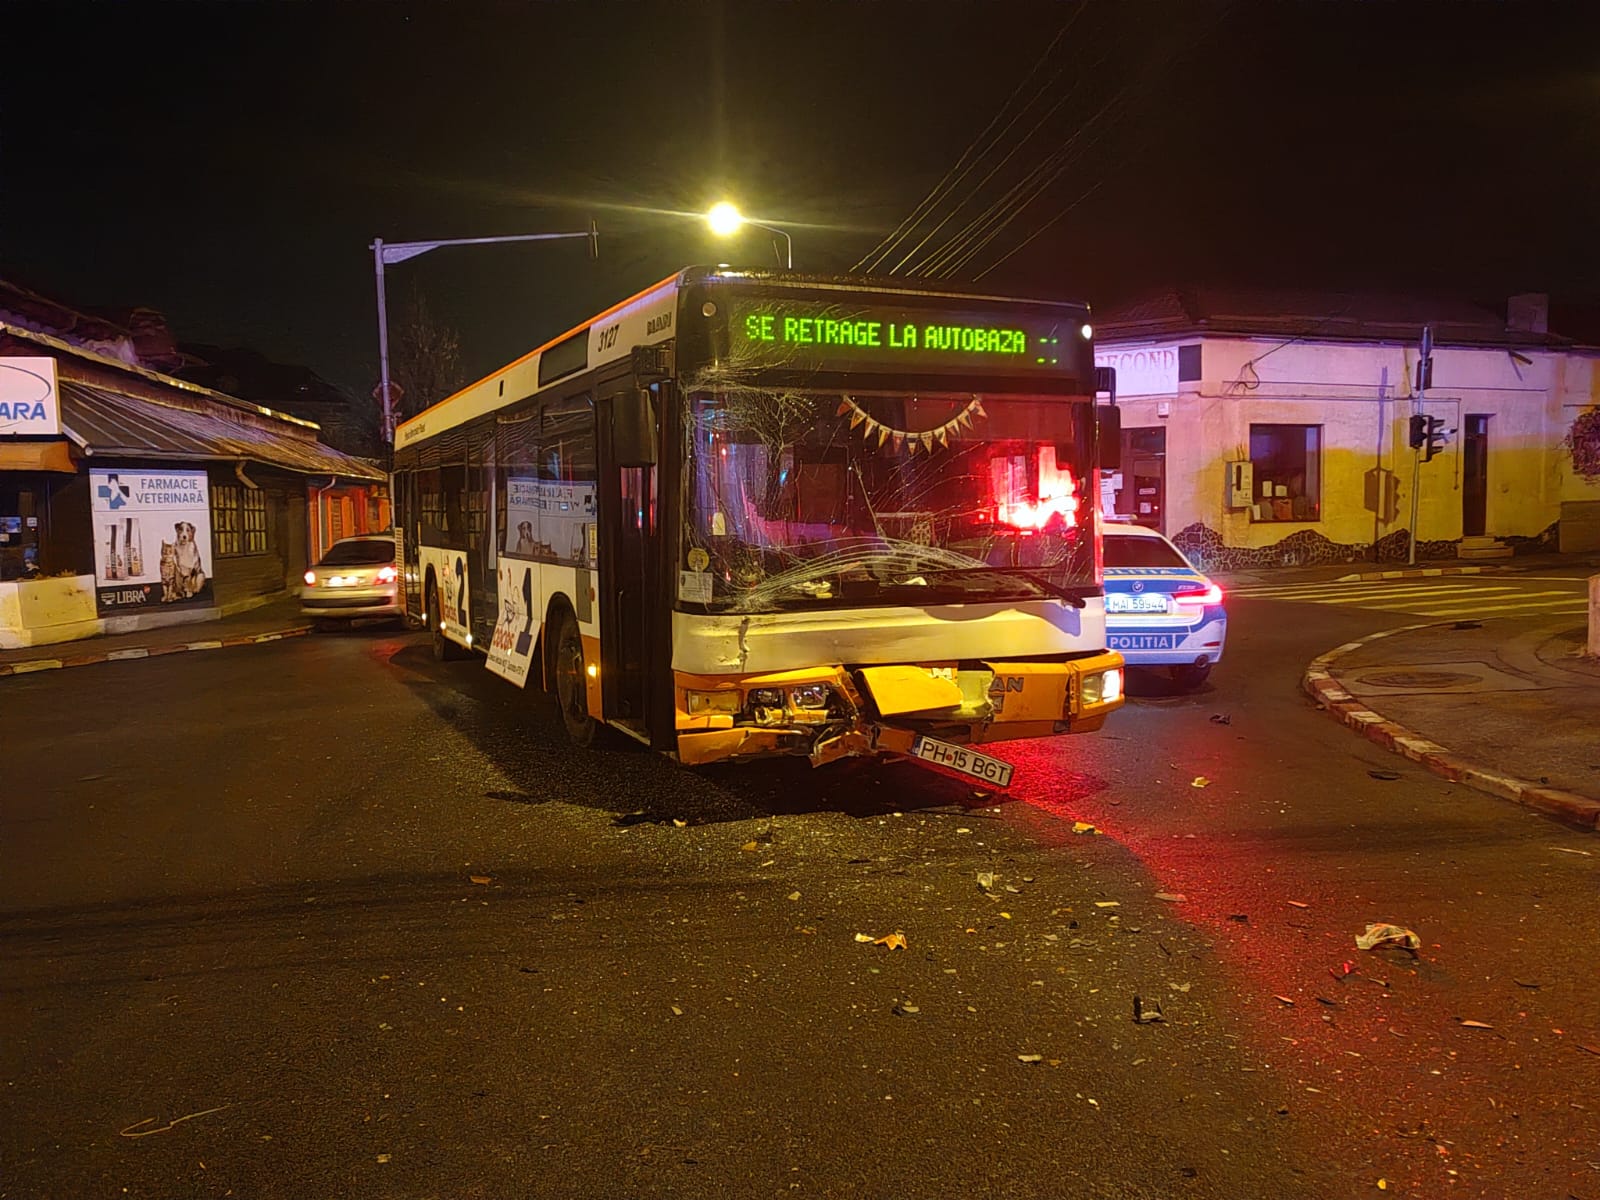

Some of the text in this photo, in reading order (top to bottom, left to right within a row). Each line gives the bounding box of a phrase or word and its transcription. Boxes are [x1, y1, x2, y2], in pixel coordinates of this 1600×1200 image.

[598, 324, 620, 352] 3127
[746, 315, 1025, 353] SE RETRAGE LA AUTOBAZA
[1096, 350, 1175, 369] ECOND
[141, 478, 198, 490] FARMACIE
[136, 491, 204, 504] VETERINARĂ
[117, 589, 147, 604] LIBRA
[1113, 600, 1128, 609] MAI
[1109, 636, 1169, 648] POLITIA
[920, 741, 1007, 782] PH 15 BGT
